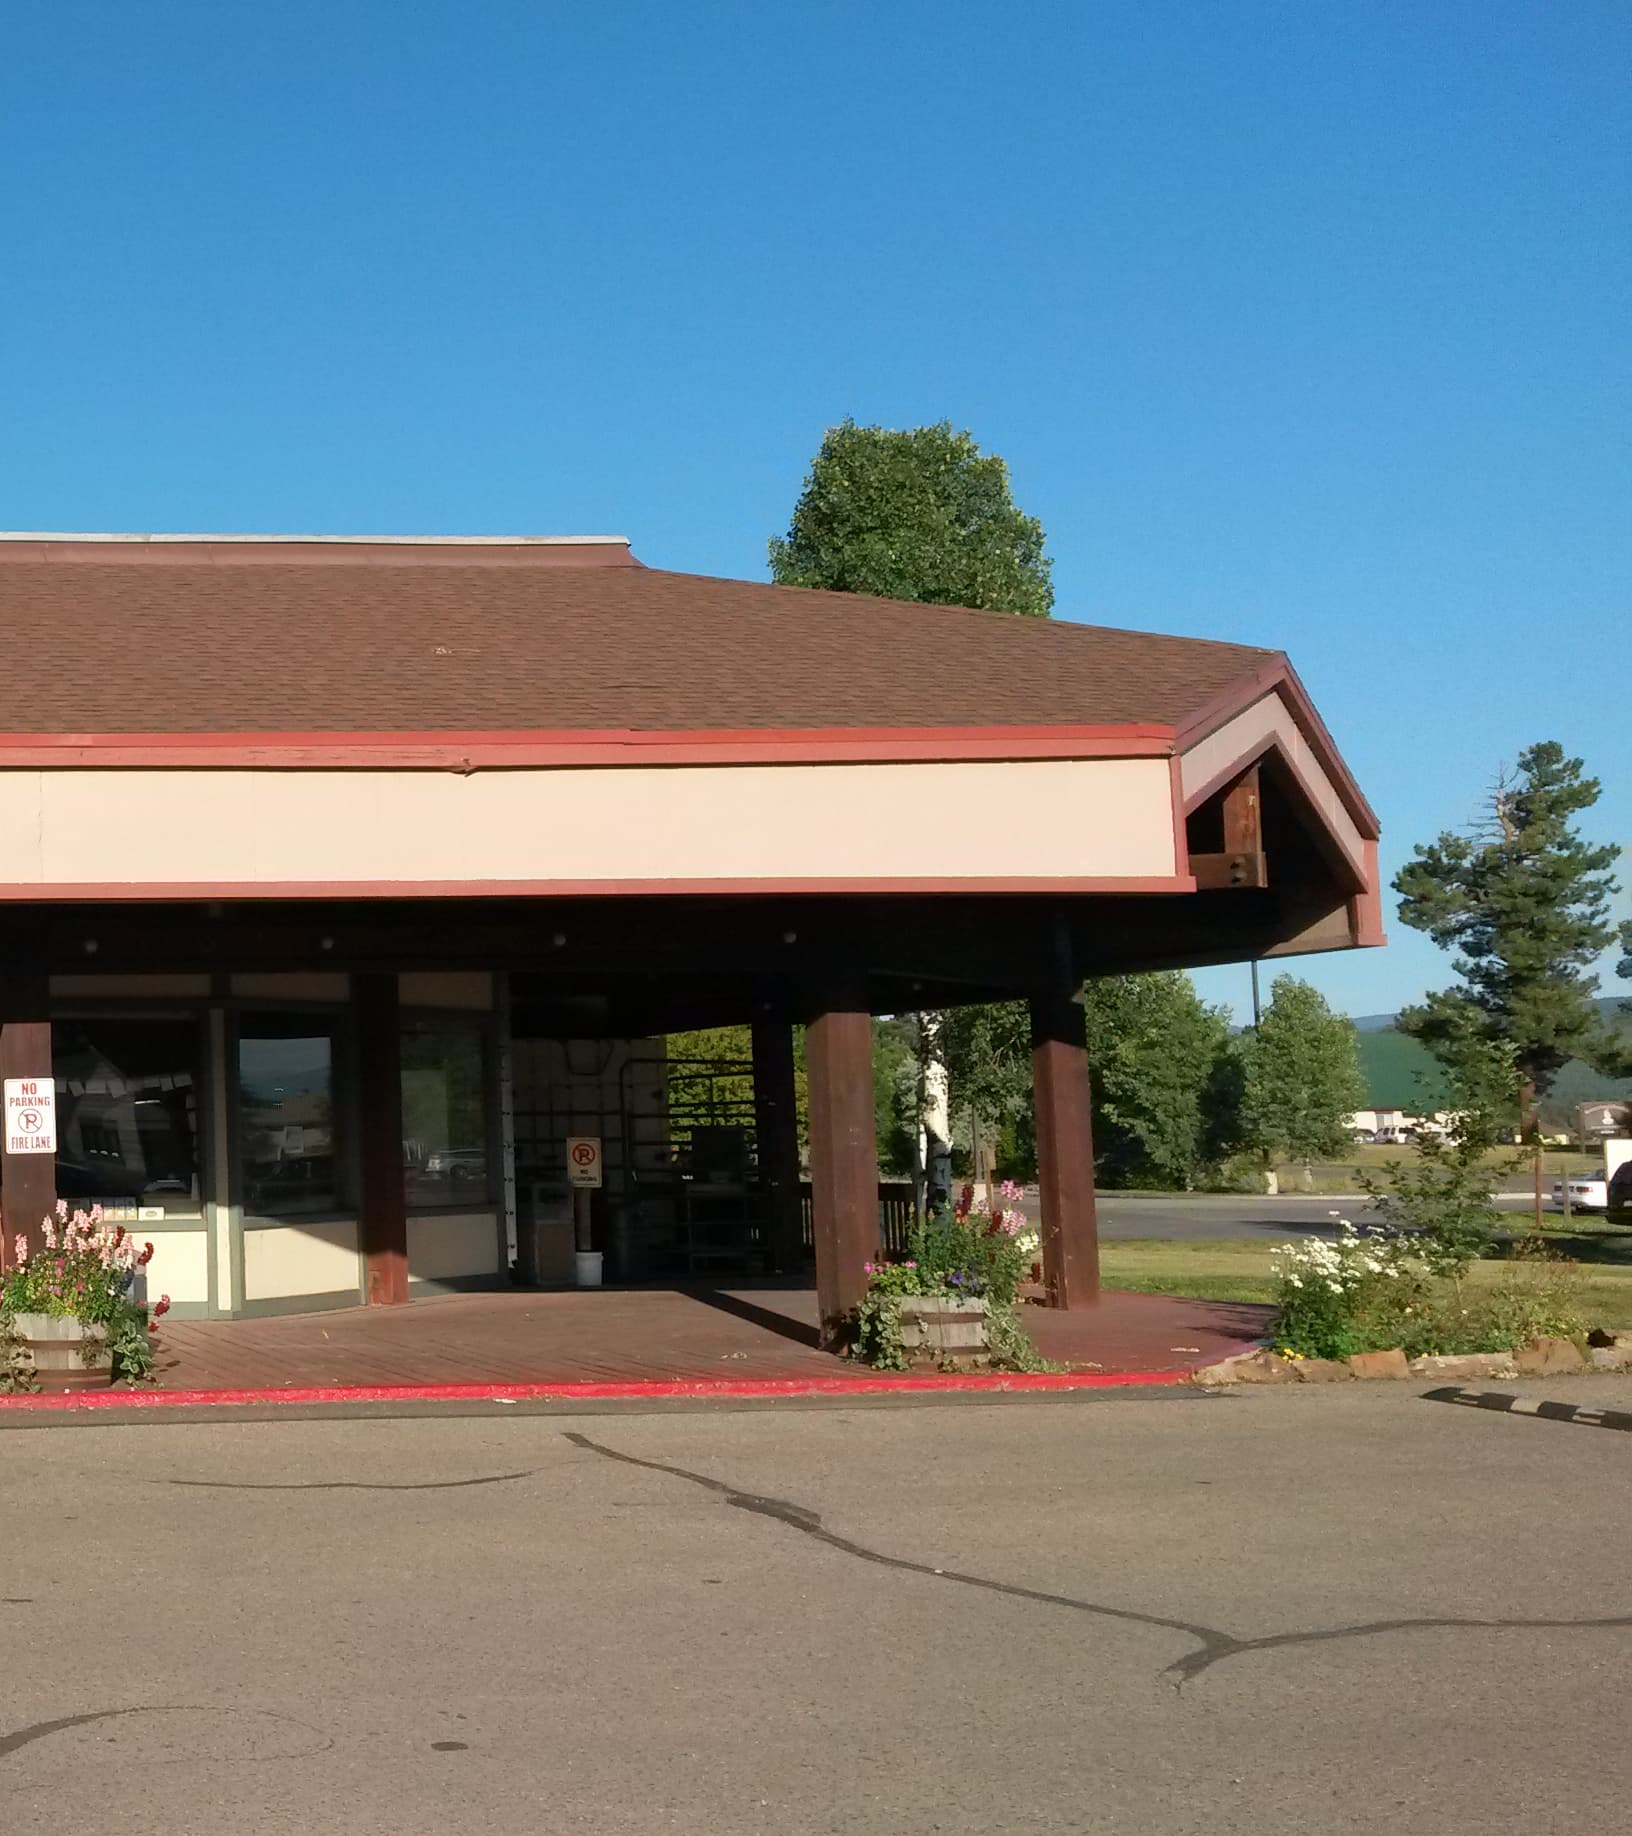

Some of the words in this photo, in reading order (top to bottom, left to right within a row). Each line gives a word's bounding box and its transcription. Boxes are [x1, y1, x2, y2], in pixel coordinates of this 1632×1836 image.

[21, 1082, 37, 1095] NO
[9, 1096, 51, 1107] PARKING
[11, 1136, 29, 1149] FIRE
[31, 1136, 51, 1149] LANE
